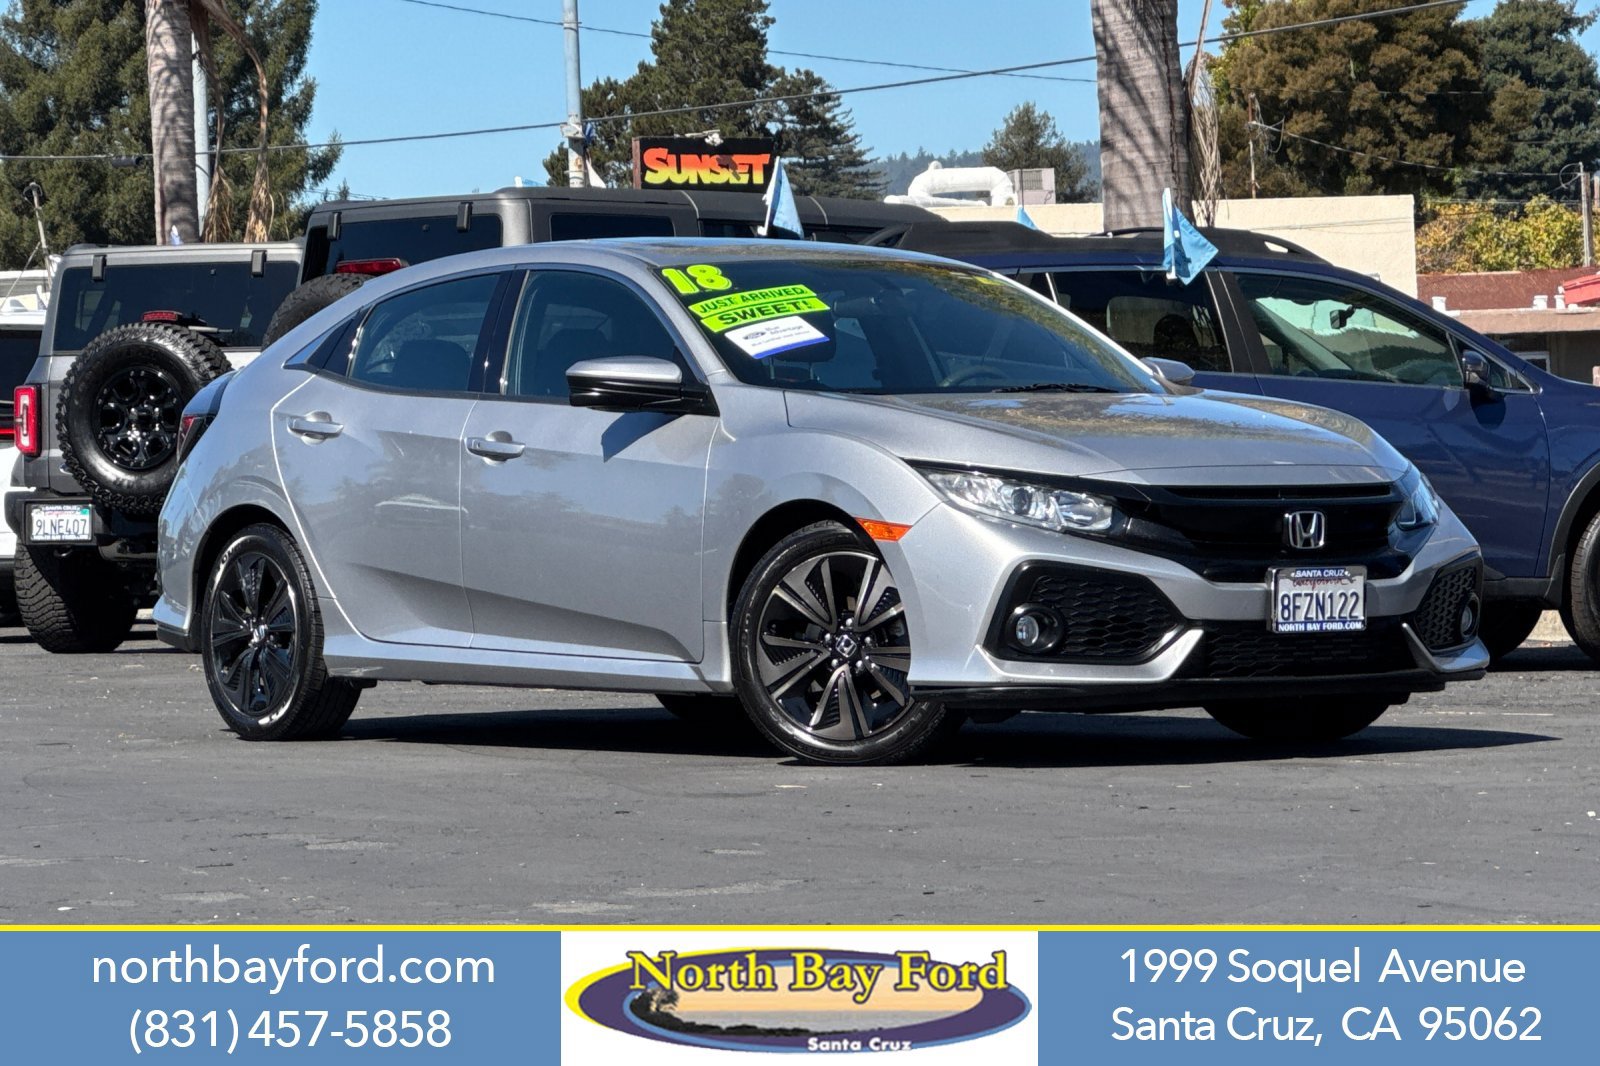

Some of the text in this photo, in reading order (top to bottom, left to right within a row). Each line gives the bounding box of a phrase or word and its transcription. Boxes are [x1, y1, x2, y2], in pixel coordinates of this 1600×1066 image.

[661, 264, 732, 294] 18
[699, 286, 805, 313] JUST ARRIVED
[718, 300, 812, 325] SWEET!
[35, 518, 87, 538] 9LNE4Q7
[1295, 569, 1345, 578] SANTA CRUZ
[1280, 591, 1360, 621] 8FZN122
[1278, 621, 1362, 632] NORTH BAY FORD.COM
